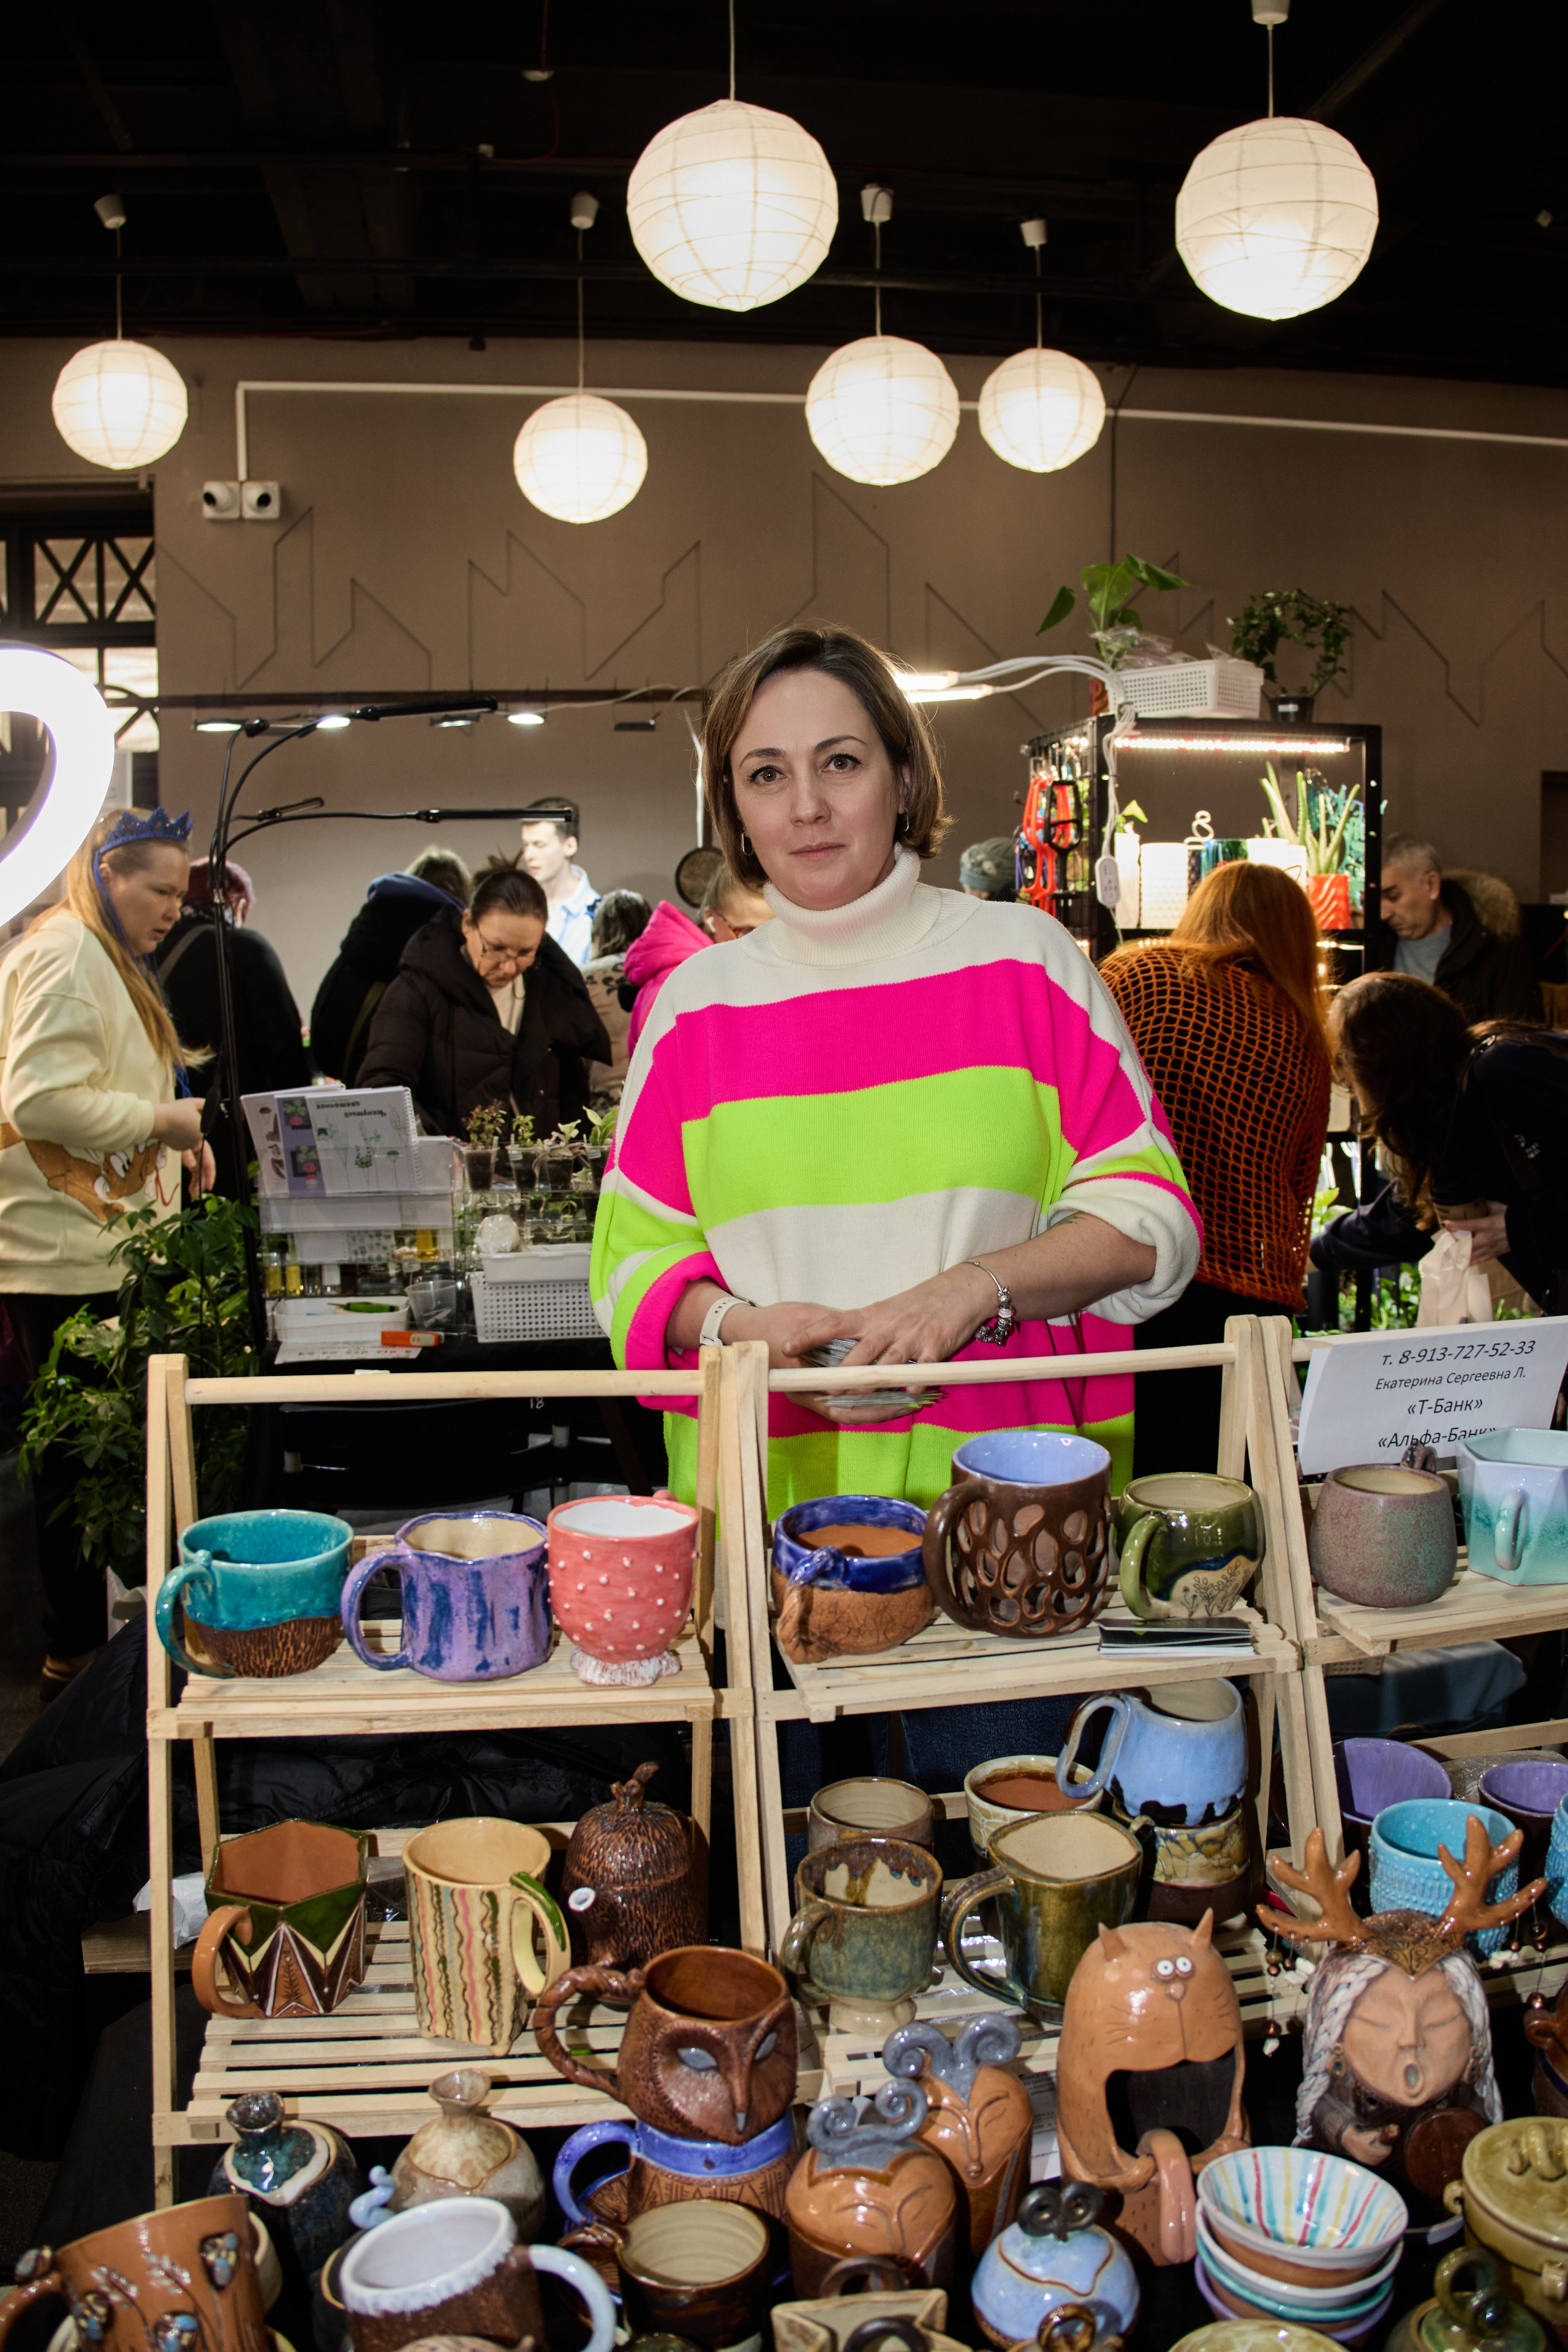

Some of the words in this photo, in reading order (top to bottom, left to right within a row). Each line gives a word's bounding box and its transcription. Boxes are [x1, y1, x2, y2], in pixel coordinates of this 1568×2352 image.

[1382, 1354, 1393, 1365] т.
[1398, 1340, 1536, 1364] 8-913-727-52-33
[1375, 1376, 1442, 1390] Екатерина
[1446, 1370, 1510, 1385] Сергеевна
[1513, 1366, 1526, 1379] Л.
[1407, 1398, 1483, 1415] «Т-Банк»
